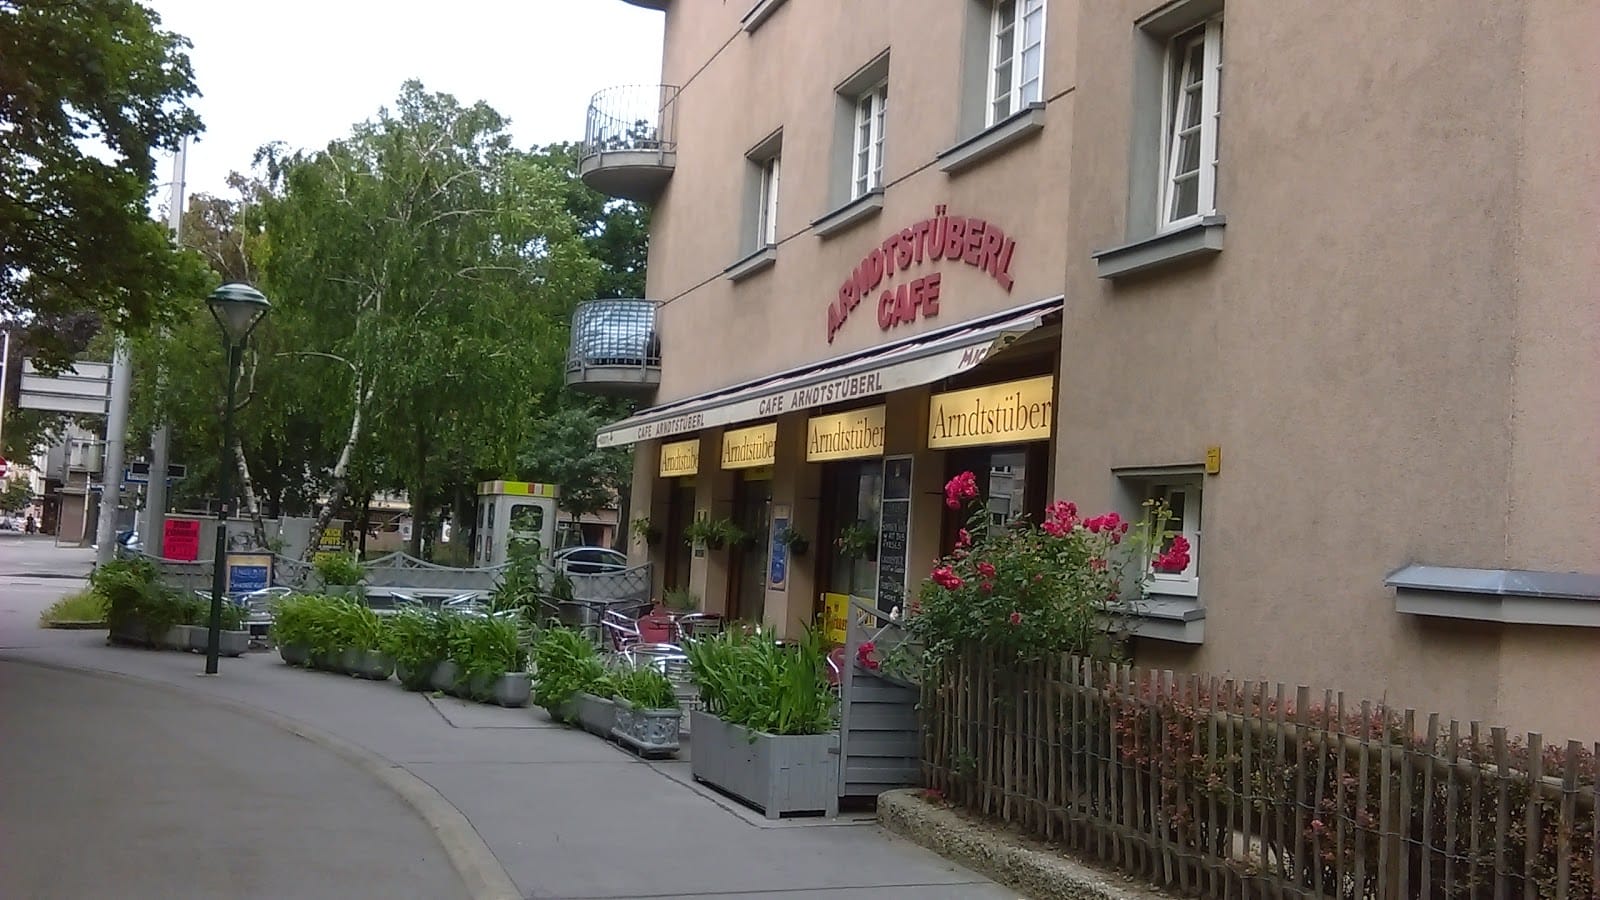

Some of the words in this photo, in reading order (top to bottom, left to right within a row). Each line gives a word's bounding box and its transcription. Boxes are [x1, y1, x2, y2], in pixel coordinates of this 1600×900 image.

[827, 204, 1016, 344] ARNDTSTÜBERL
[877, 272, 941, 331] CAFE
[759, 395, 784, 415] CAFE
[791, 371, 883, 409] ARNDTSTÜBERL
[932, 391, 1051, 440] Arndtstüber
[637, 425, 652, 439] CAFE
